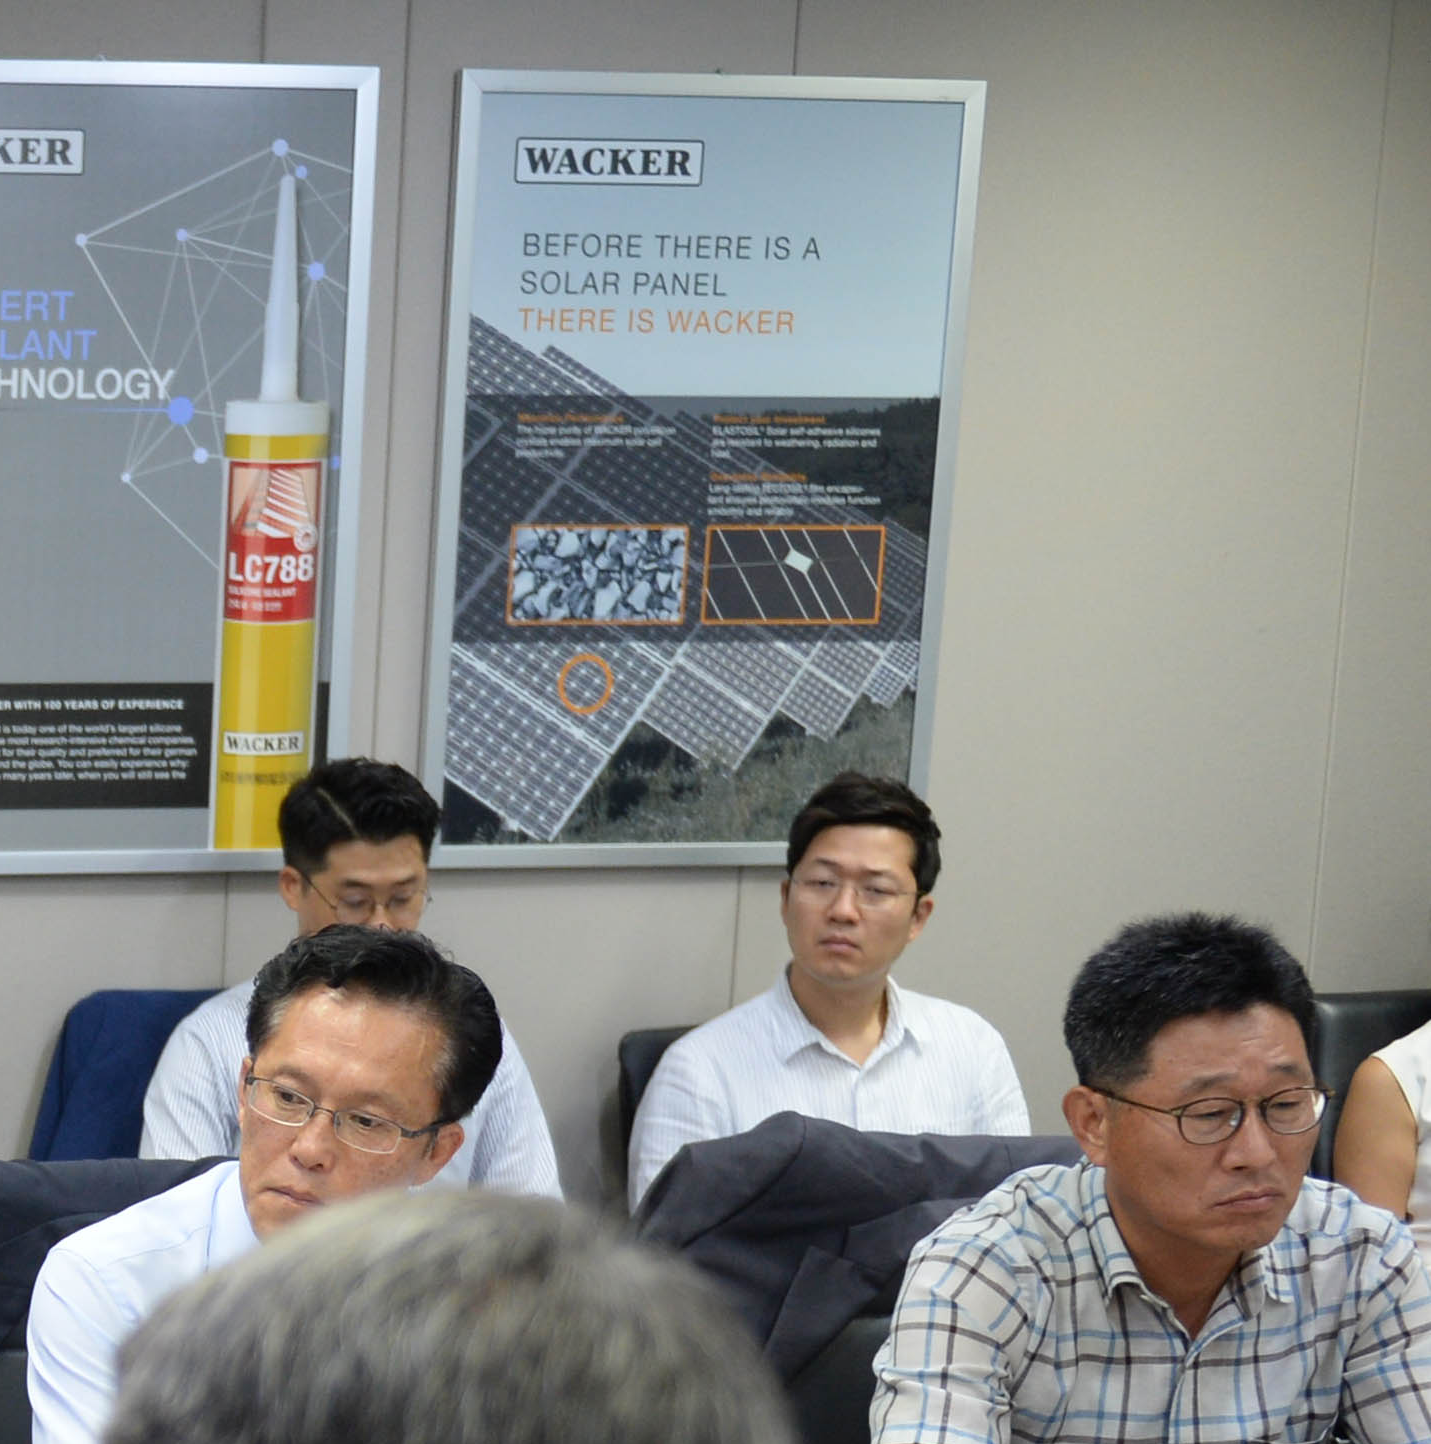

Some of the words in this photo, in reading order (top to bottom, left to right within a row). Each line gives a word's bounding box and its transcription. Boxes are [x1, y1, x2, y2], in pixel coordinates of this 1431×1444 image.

[524, 147, 692, 177] WACKER
[523, 233, 643, 258] BEFORE
[656, 235, 751, 260] THERE
[765, 236, 791, 260] IS
[802, 237, 821, 261] A
[519, 270, 620, 296] SOLAR
[633, 272, 728, 297] PANEL
[518, 307, 615, 333] THERE
[628, 309, 654, 333] IS
[667, 310, 795, 335] WACKER
[228, 552, 314, 584] LC788
[227, 735, 299, 752] WACKER
